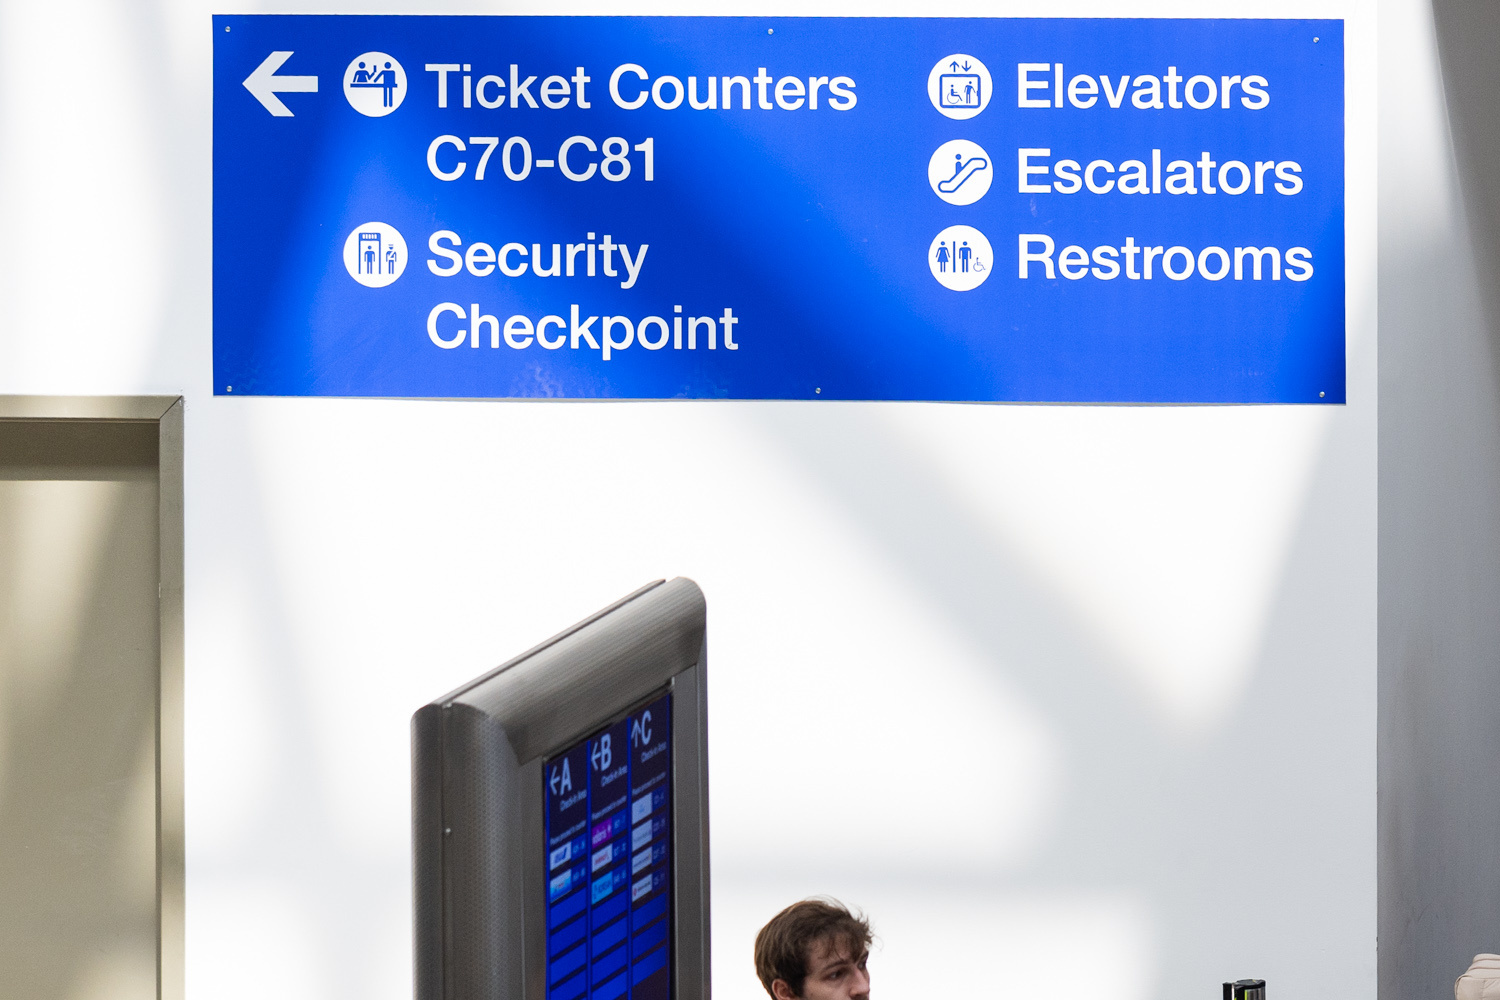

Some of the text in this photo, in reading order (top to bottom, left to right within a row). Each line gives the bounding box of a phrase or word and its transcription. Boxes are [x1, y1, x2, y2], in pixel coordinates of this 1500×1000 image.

[425, 64, 857, 110] Ticket Counters
[1017, 63, 1270, 110] Elevators
[426, 135, 654, 182] C70-C81
[1017, 148, 1304, 196] Escalators
[426, 230, 648, 290] Security
[1017, 234, 1314, 282] Restrooms
[426, 302, 739, 361] Checkpoint
[641, 709, 652, 746] C
[601, 733, 612, 772] B
[560, 757, 572, 796] A
